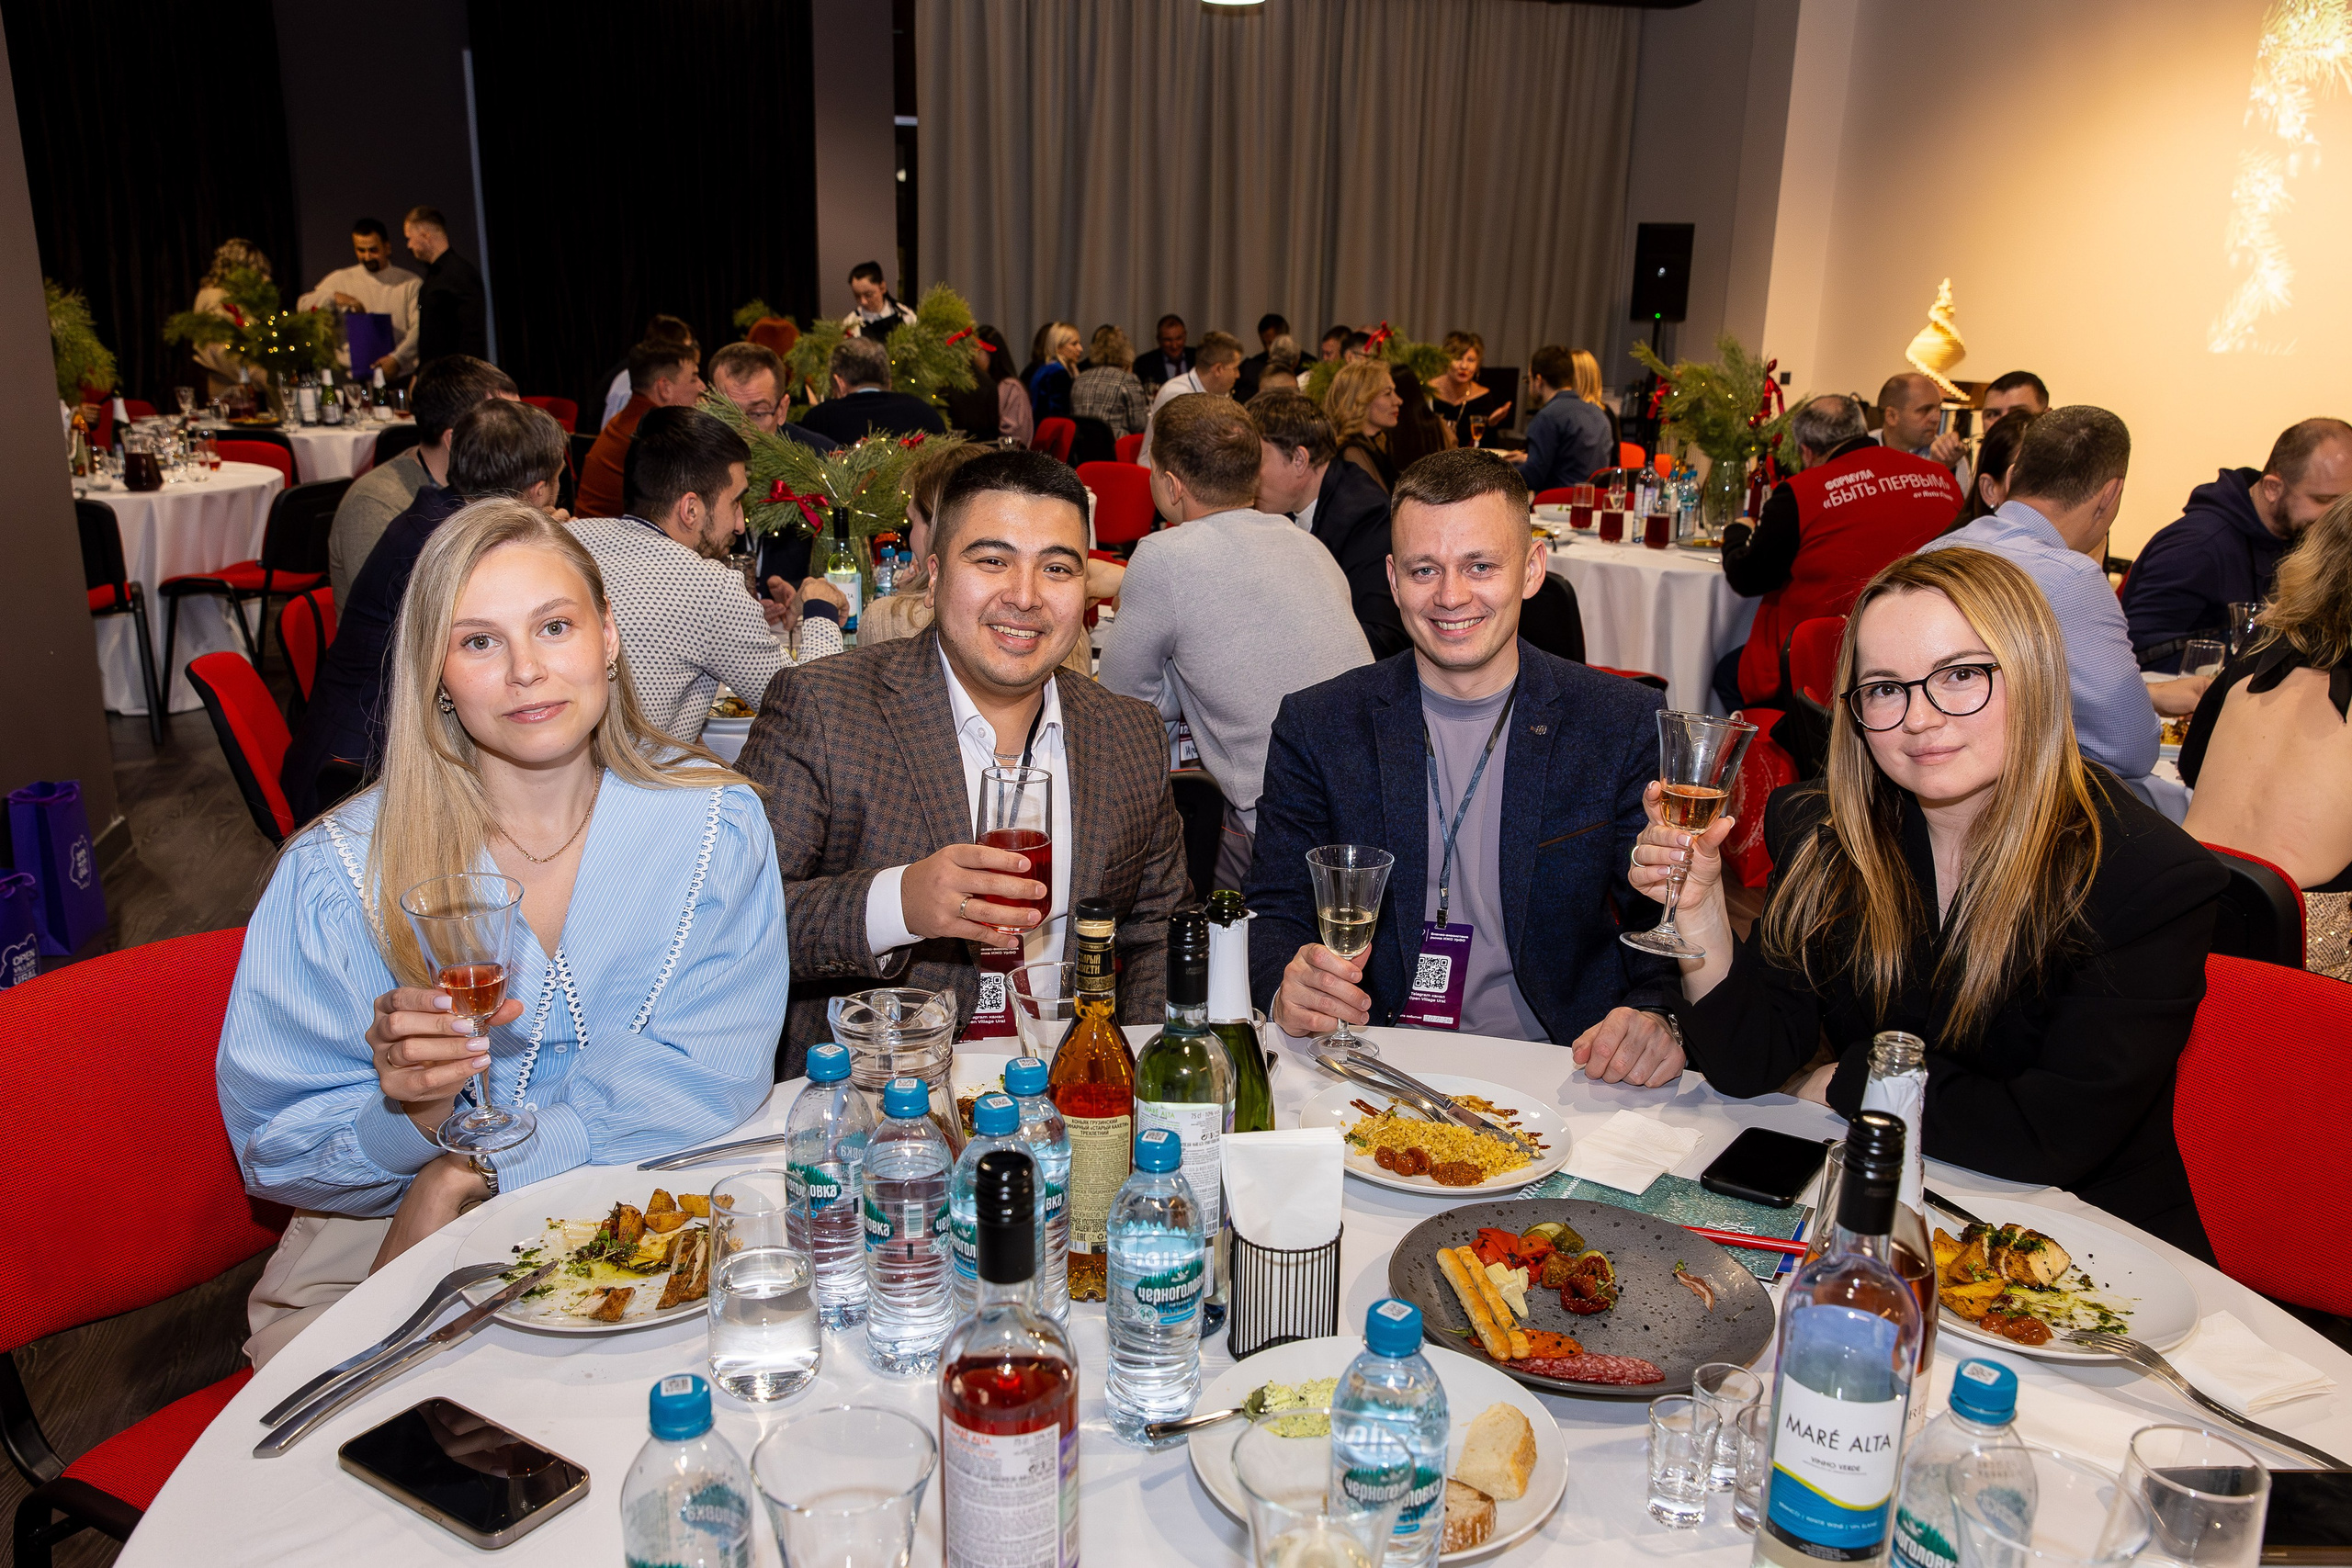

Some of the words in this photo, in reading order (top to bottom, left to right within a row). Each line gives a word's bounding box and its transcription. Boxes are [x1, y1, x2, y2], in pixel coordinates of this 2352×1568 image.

[1823, 481, 1877, 509] «БЫТЬ
[1878, 473, 1951, 492] ПЕРВЫМ»
[1825, 468, 1875, 491] ФОРМУЛА
[1785, 1412, 1839, 1450] MARÉ
[1849, 1433, 1892, 1452] ALTA
[1810, 1456, 1836, 1469] VINHO
[1838, 1463, 1860, 1472] VERDE
